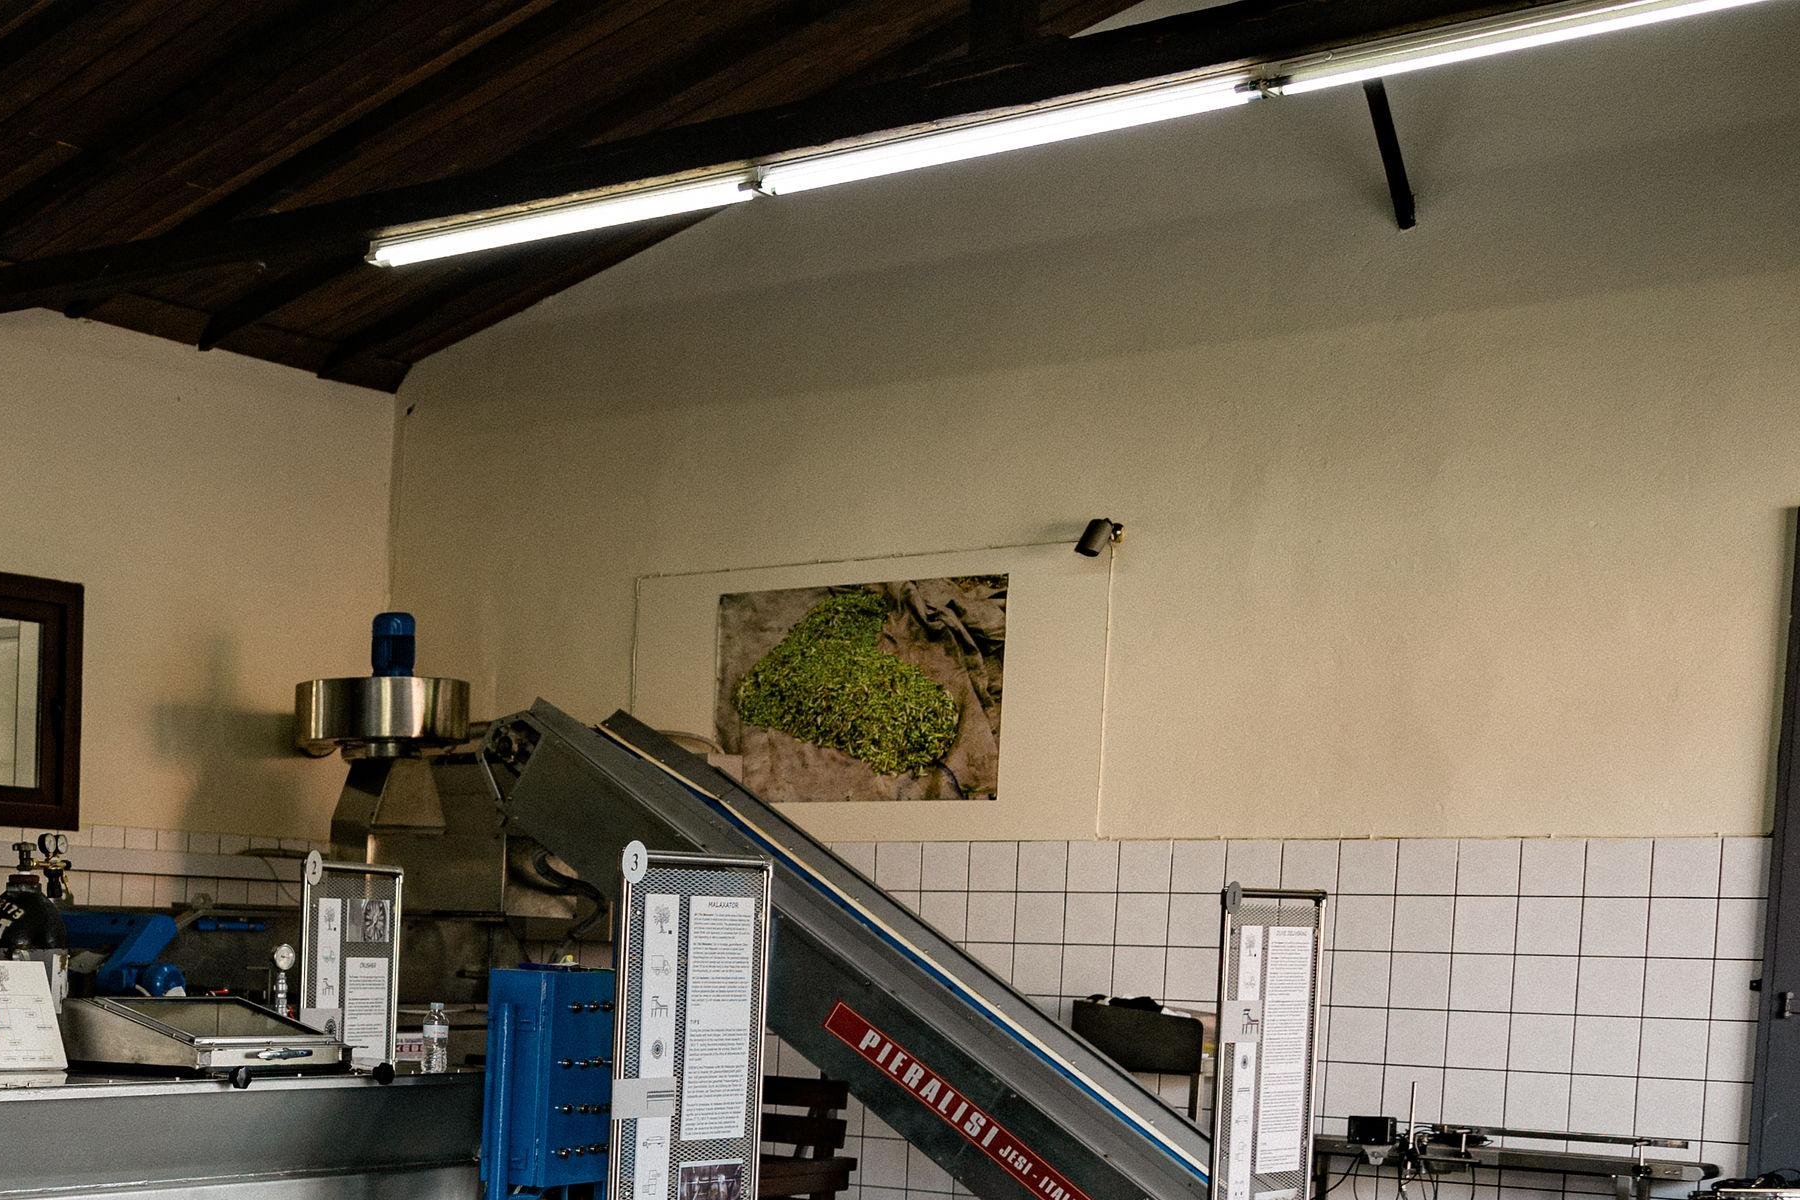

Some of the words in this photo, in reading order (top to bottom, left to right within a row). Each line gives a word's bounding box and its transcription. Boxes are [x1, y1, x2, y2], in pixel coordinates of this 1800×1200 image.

[311, 860, 317, 875] 2
[630, 853, 639, 872] 3
[708, 901, 740, 909] MALAXATOR
[858, 1028, 1000, 1148] PIERALISI
[998, 1144, 1032, 1176] JESI
